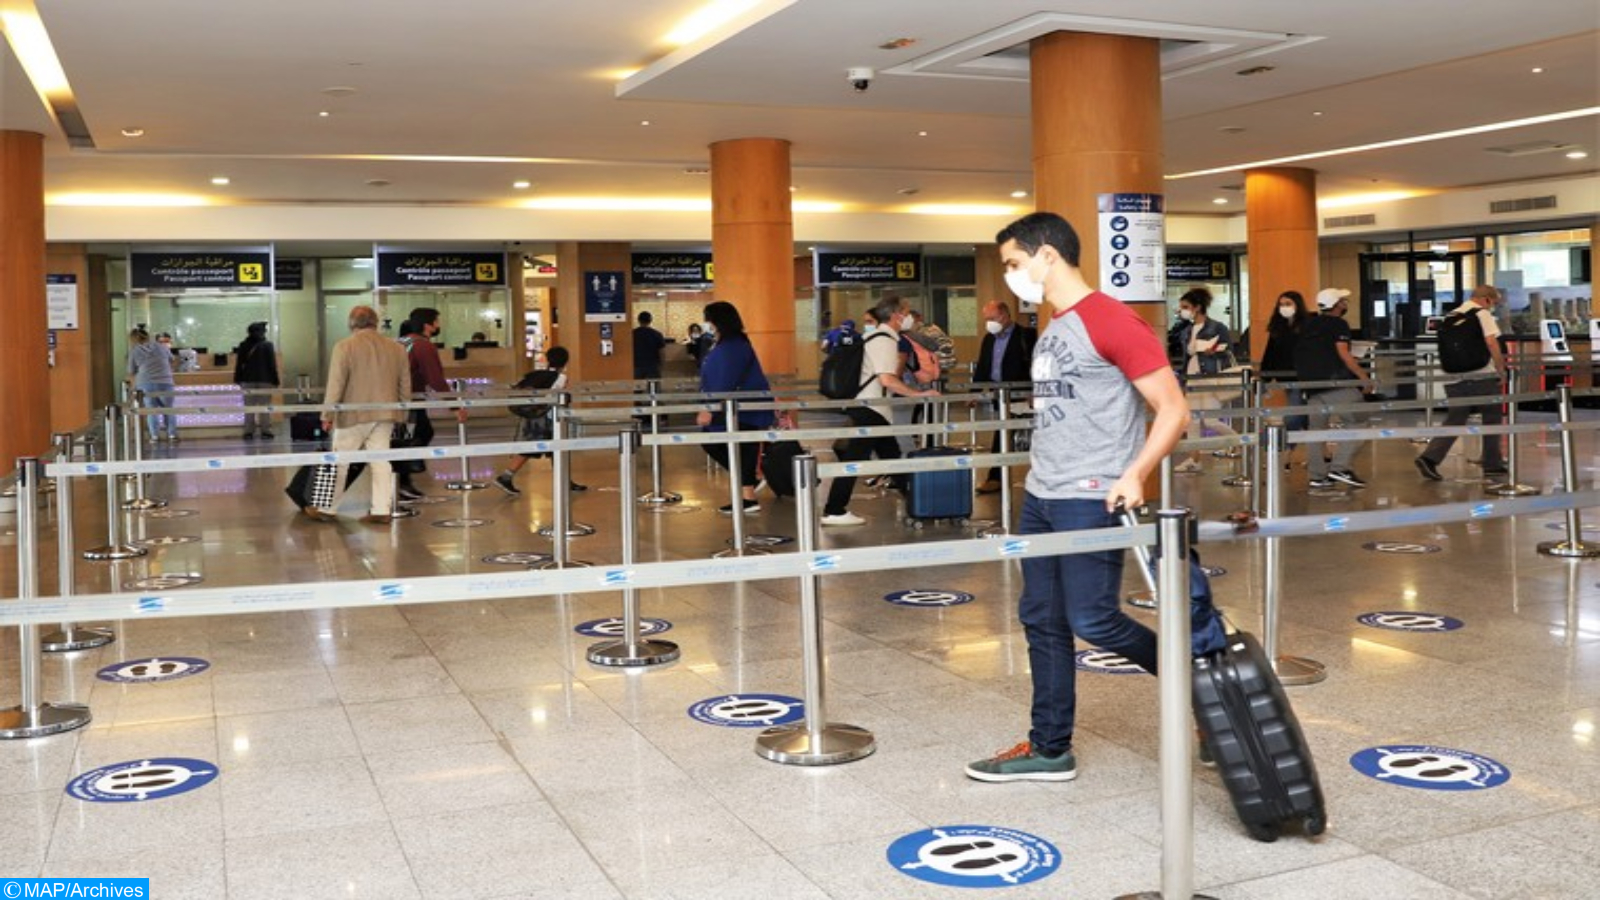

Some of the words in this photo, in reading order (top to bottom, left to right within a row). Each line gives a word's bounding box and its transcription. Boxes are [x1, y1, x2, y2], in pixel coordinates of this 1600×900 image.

[151, 267, 189, 276] Contrôle
[190, 267, 234, 277] passeport
[396, 266, 430, 274] Contrôle
[432, 267, 471, 275] passeport
[164, 275, 202, 284] Passport
[408, 273, 443, 281] Passport
